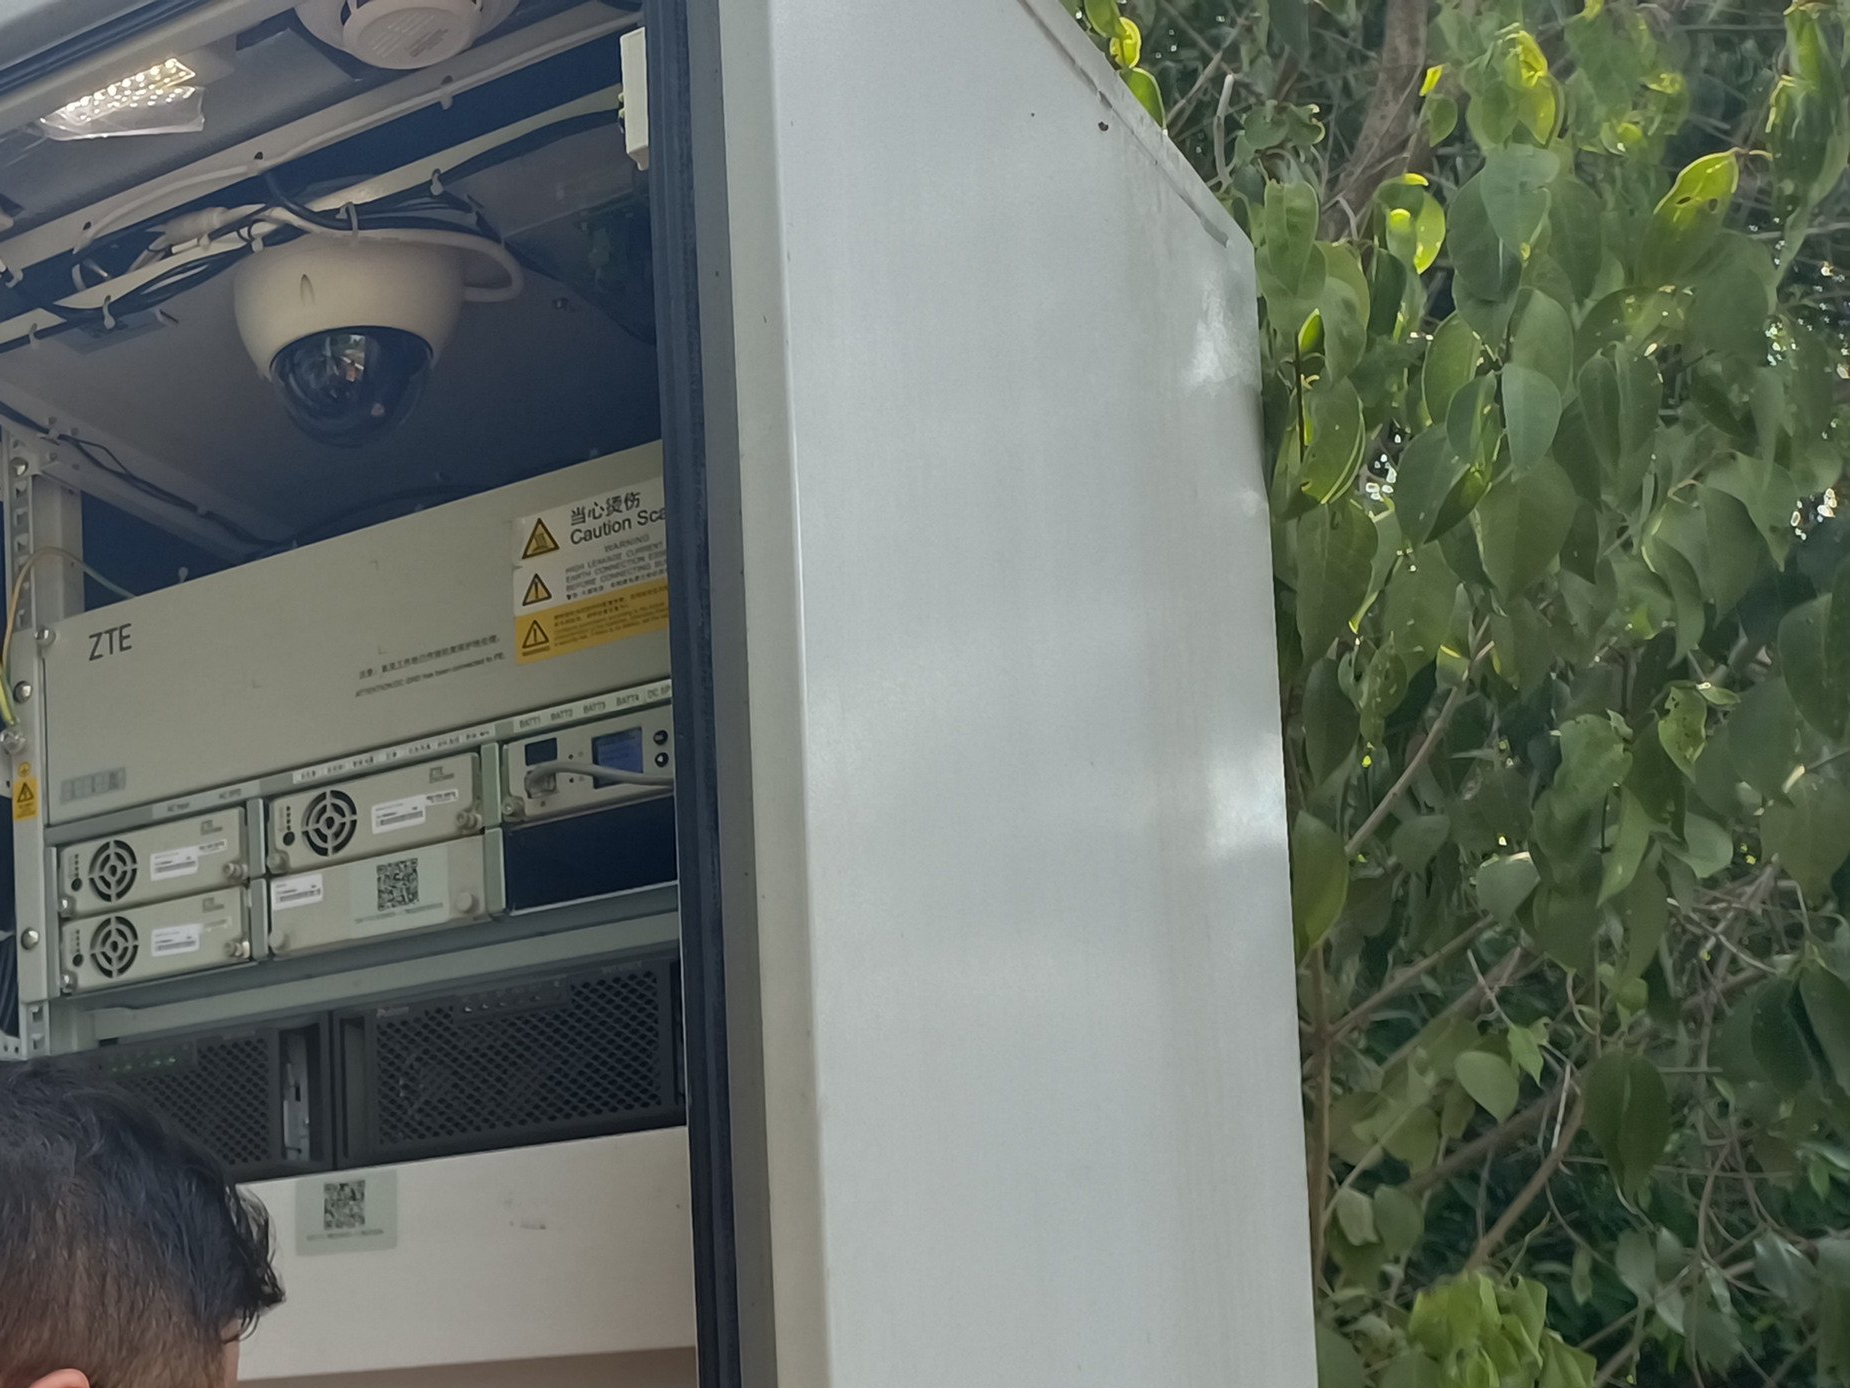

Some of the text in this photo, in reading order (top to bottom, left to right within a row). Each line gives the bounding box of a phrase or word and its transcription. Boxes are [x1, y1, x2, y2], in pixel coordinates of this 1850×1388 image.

[570, 491, 641, 526] 当心烫伤
[570, 517, 632, 545] Caution
[603, 533, 650, 553] WARNING
[88, 622, 133, 662] ZTE
